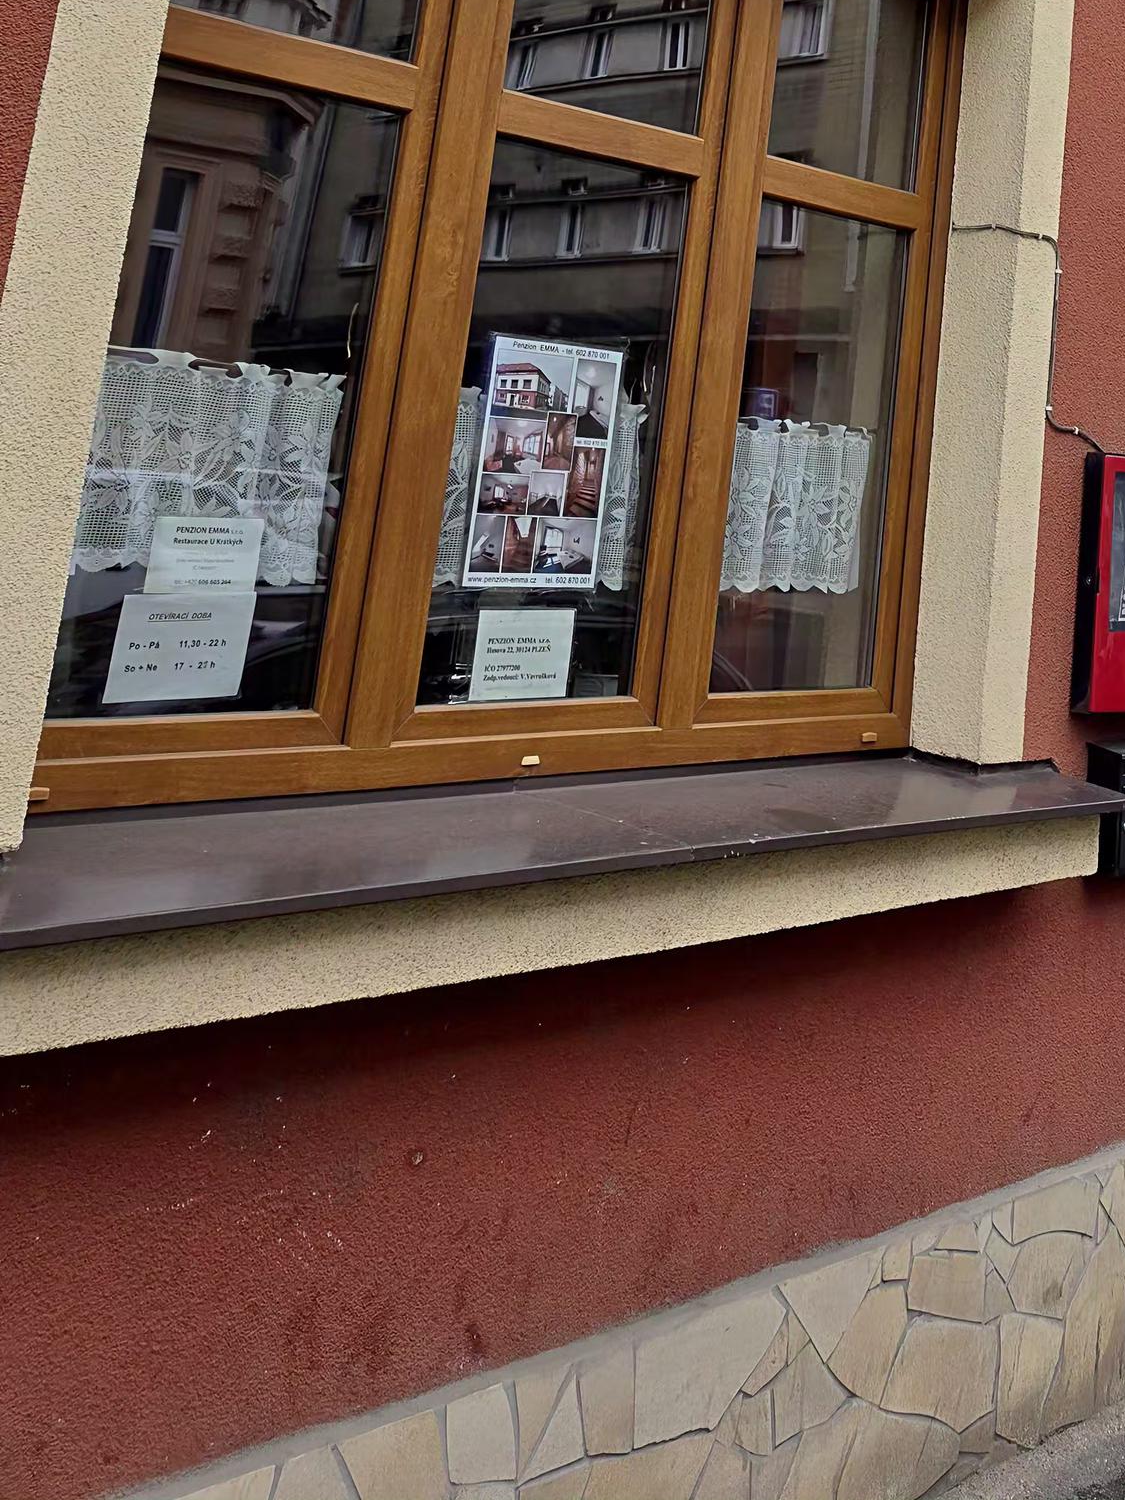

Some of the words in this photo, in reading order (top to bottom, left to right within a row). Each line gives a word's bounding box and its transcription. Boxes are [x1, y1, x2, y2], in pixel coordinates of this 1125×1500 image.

[512, 340, 537, 351] Penzion
[540, 344, 560, 354] EMMA
[175, 526, 207, 534] PENZION
[173, 537, 209, 545] Restaurace
[148, 612, 190, 620] OTEVÍRACÍ
[128, 642, 140, 650] Po
[208, 639, 219, 647] 22
[221, 639, 226, 647] h
[488, 637, 515, 645] PENZION
[531, 644, 551, 653] PLZEŇ
[124, 665, 136, 673] So
[146, 663, 158, 671] Ne
[174, 662, 184, 670] 17
